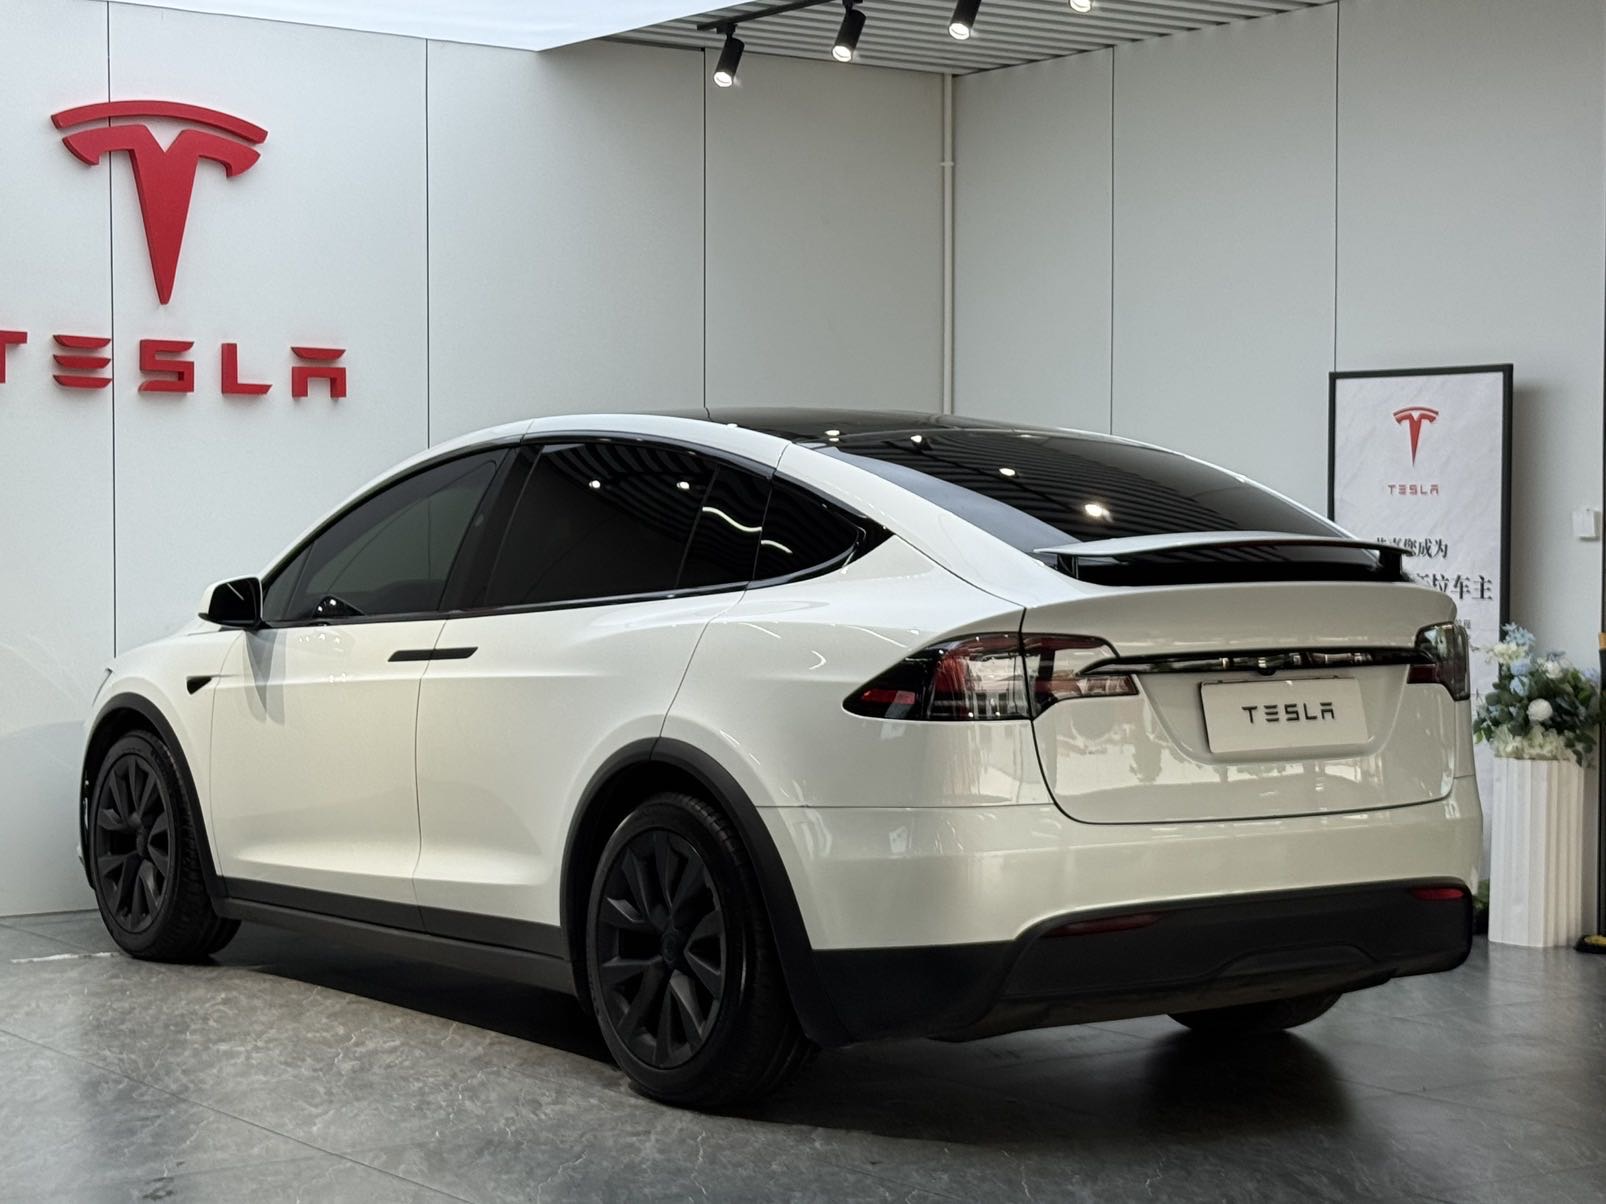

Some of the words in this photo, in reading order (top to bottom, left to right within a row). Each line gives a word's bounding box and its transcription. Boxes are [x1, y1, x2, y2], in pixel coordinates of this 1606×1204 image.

[1387, 484, 1440, 496] TESLA
[1416, 573, 1494, 601] 拉车主
[1241, 701, 1335, 724] TESLA
